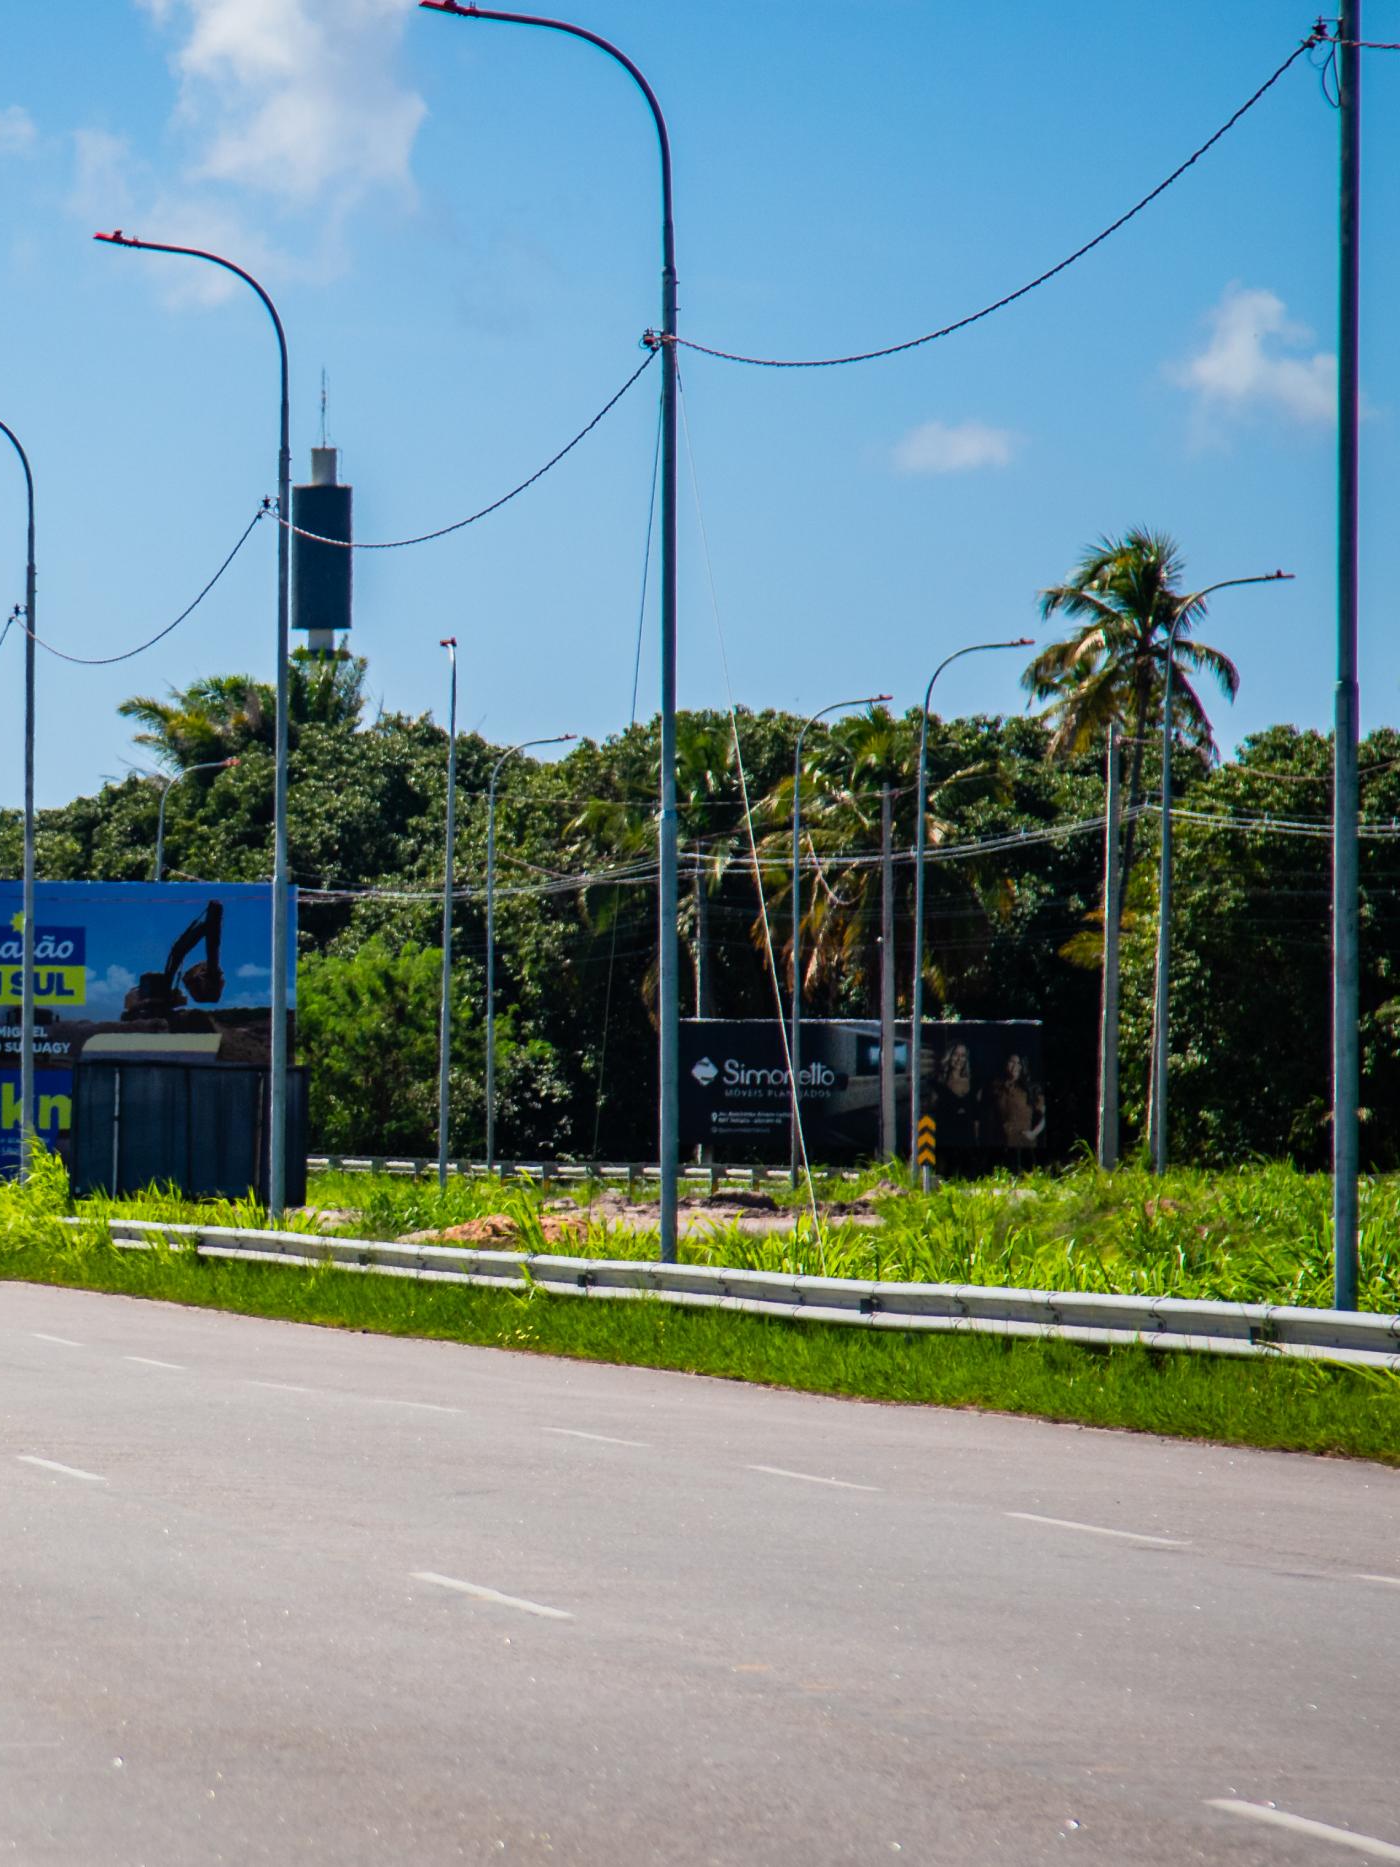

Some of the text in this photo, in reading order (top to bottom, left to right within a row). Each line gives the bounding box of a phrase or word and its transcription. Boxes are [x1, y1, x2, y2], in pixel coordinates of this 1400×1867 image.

[10, 970, 75, 997] SUL
[5, 1042, 71, 1055] SUUAGY
[767, 1089, 832, 1098] PLANADOS
